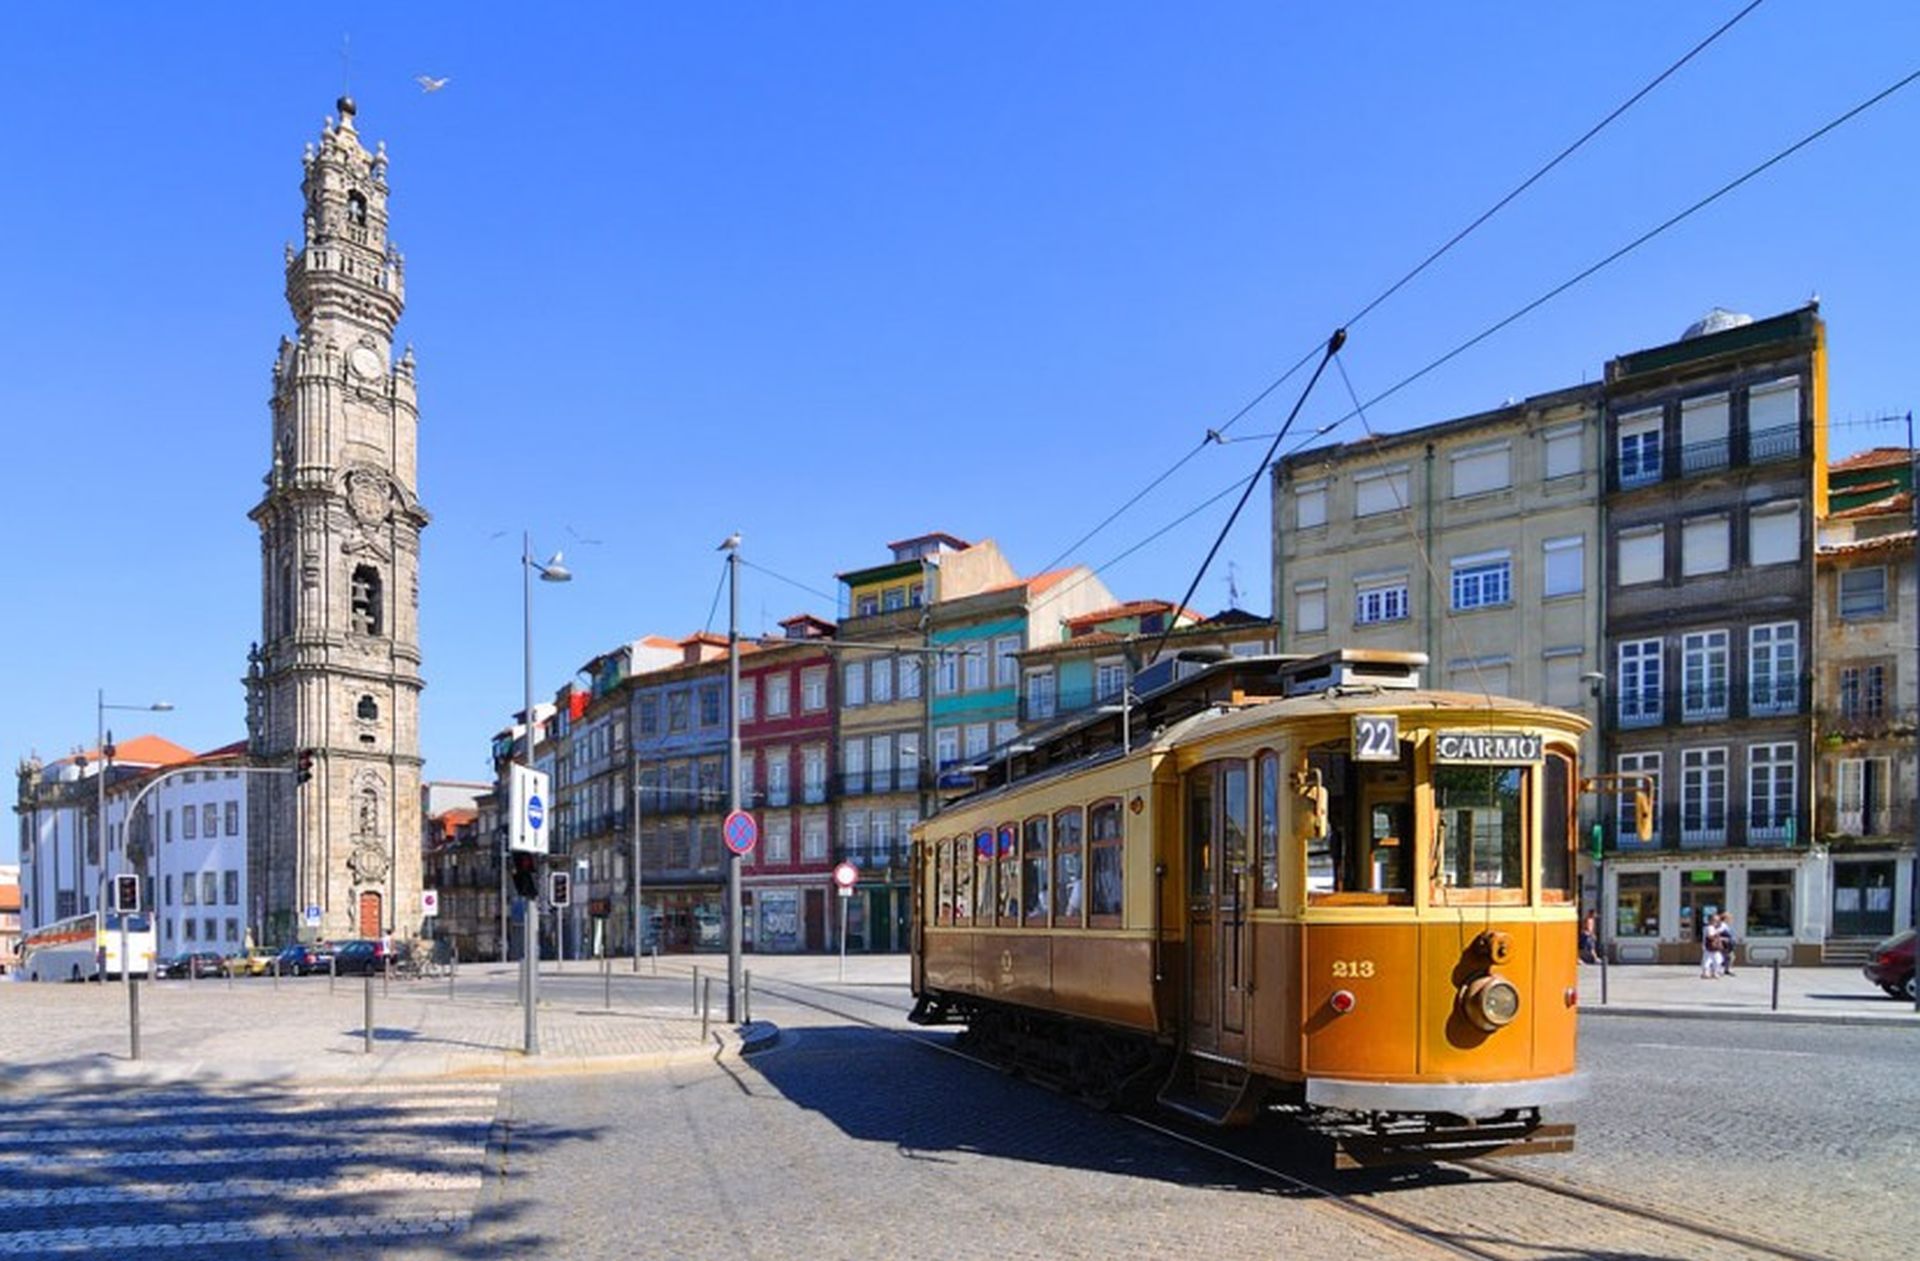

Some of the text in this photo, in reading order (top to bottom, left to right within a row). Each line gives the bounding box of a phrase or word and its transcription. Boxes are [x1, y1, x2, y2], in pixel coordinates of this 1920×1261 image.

[1360, 721, 1393, 756] 22
[1440, 736, 1537, 759] CARMO
[1332, 959, 1376, 978] 213
